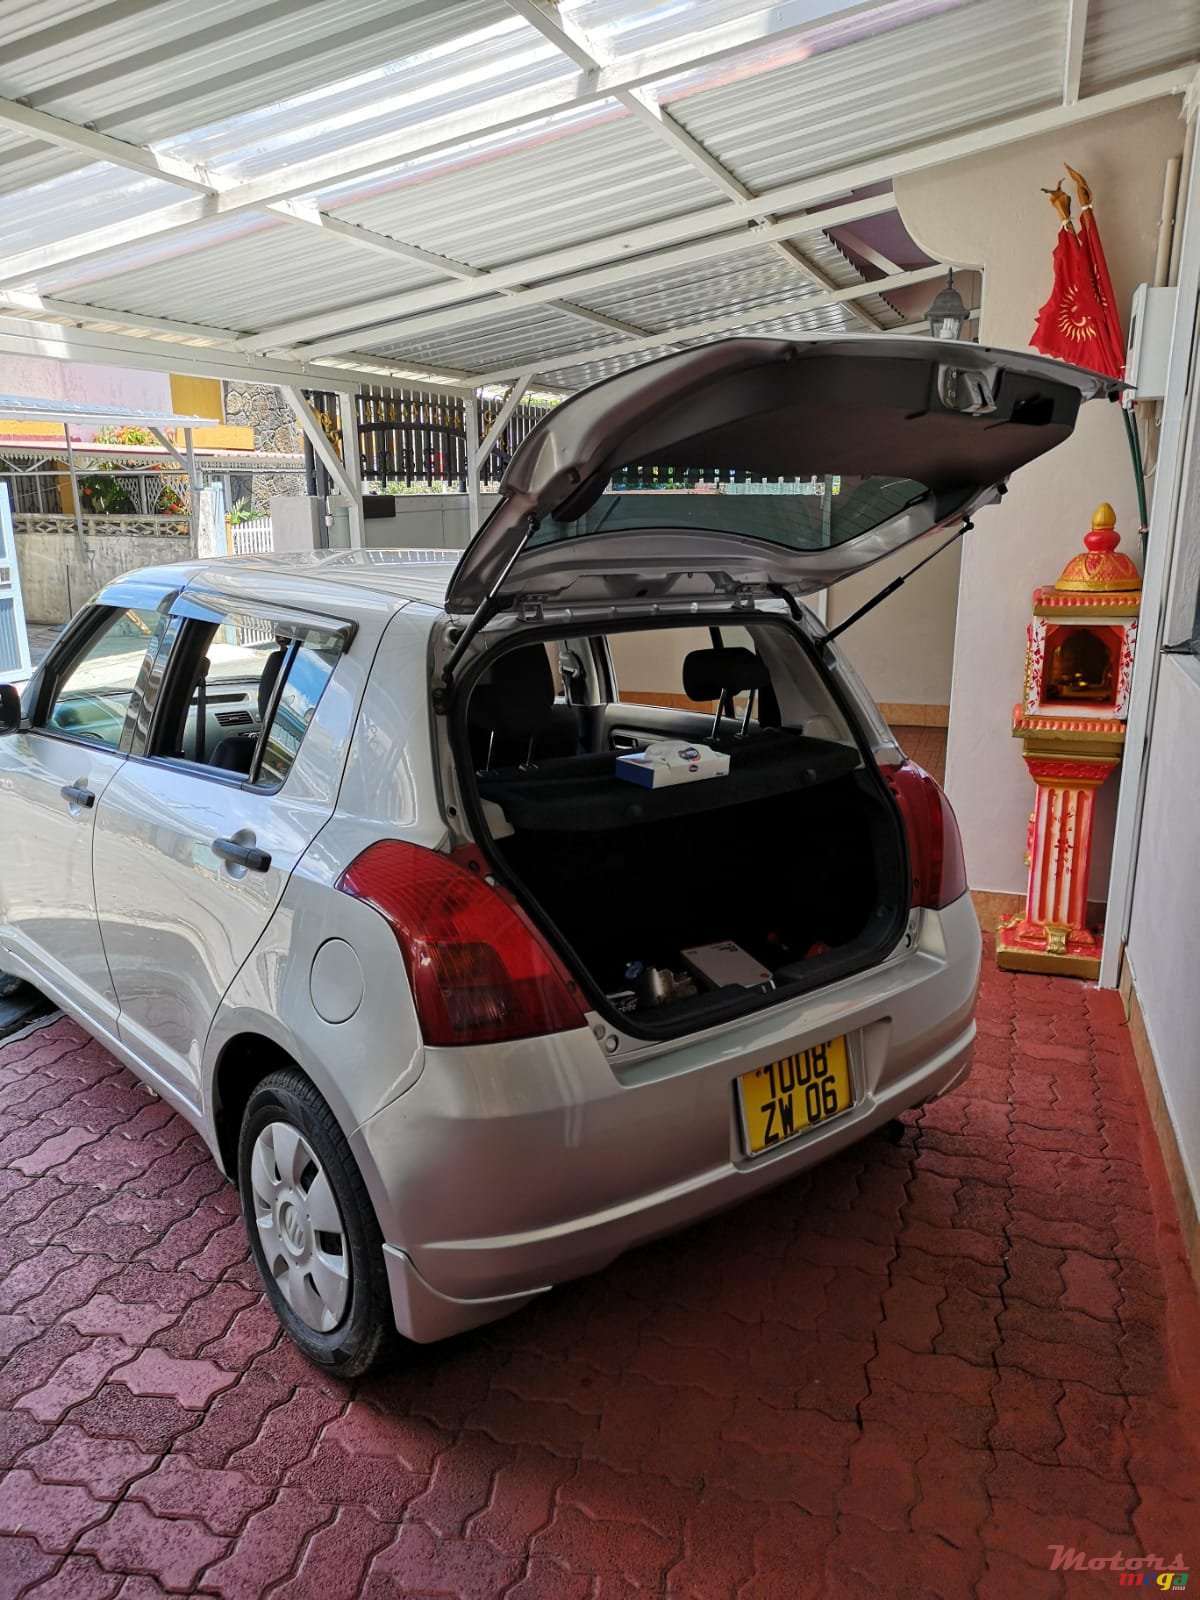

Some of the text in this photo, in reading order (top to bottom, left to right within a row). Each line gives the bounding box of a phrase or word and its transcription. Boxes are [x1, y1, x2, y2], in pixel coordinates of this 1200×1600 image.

[763, 1043, 829, 1099] 1008
[760, 1075, 838, 1146] ZW 06
